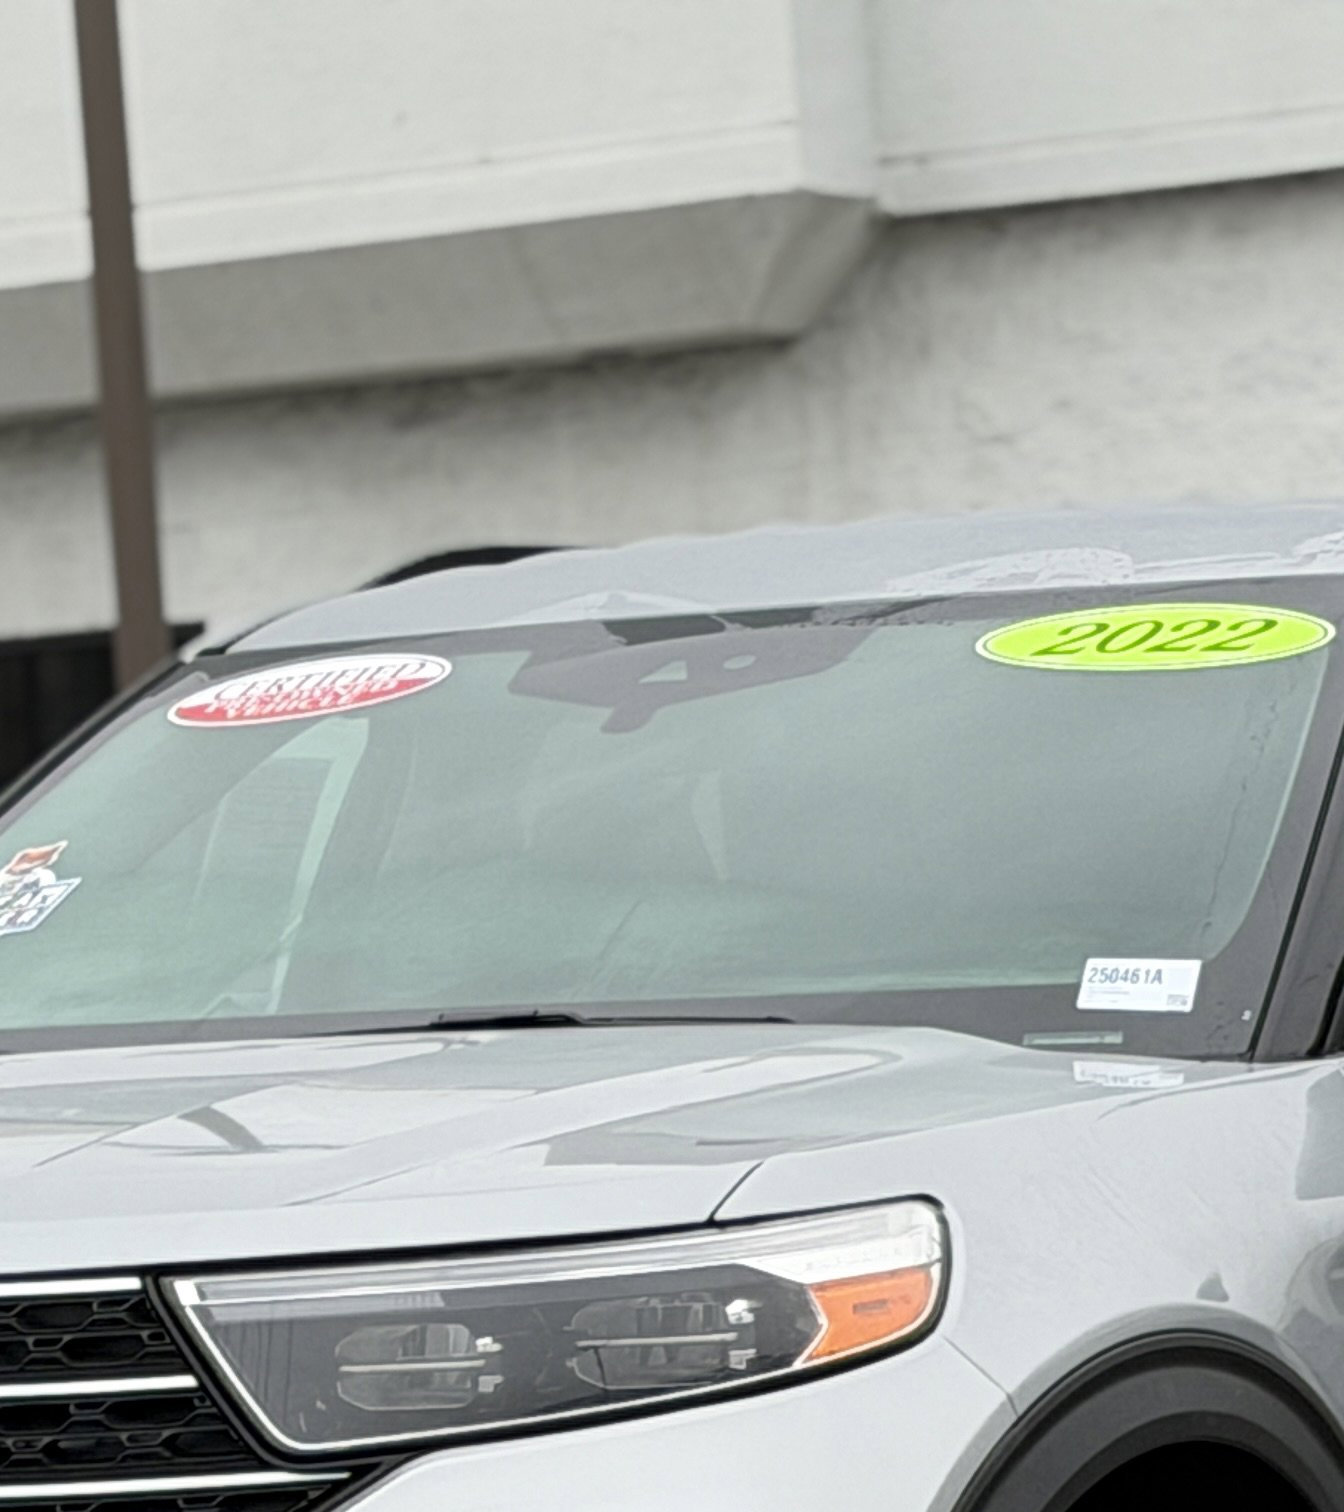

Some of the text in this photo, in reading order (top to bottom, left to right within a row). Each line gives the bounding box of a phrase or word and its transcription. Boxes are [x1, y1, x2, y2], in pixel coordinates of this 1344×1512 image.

[1029, 618, 1279, 656] 2022
[213, 662, 427, 701] CERTIFIED
[1087, 967, 1164, 985] 250461A
